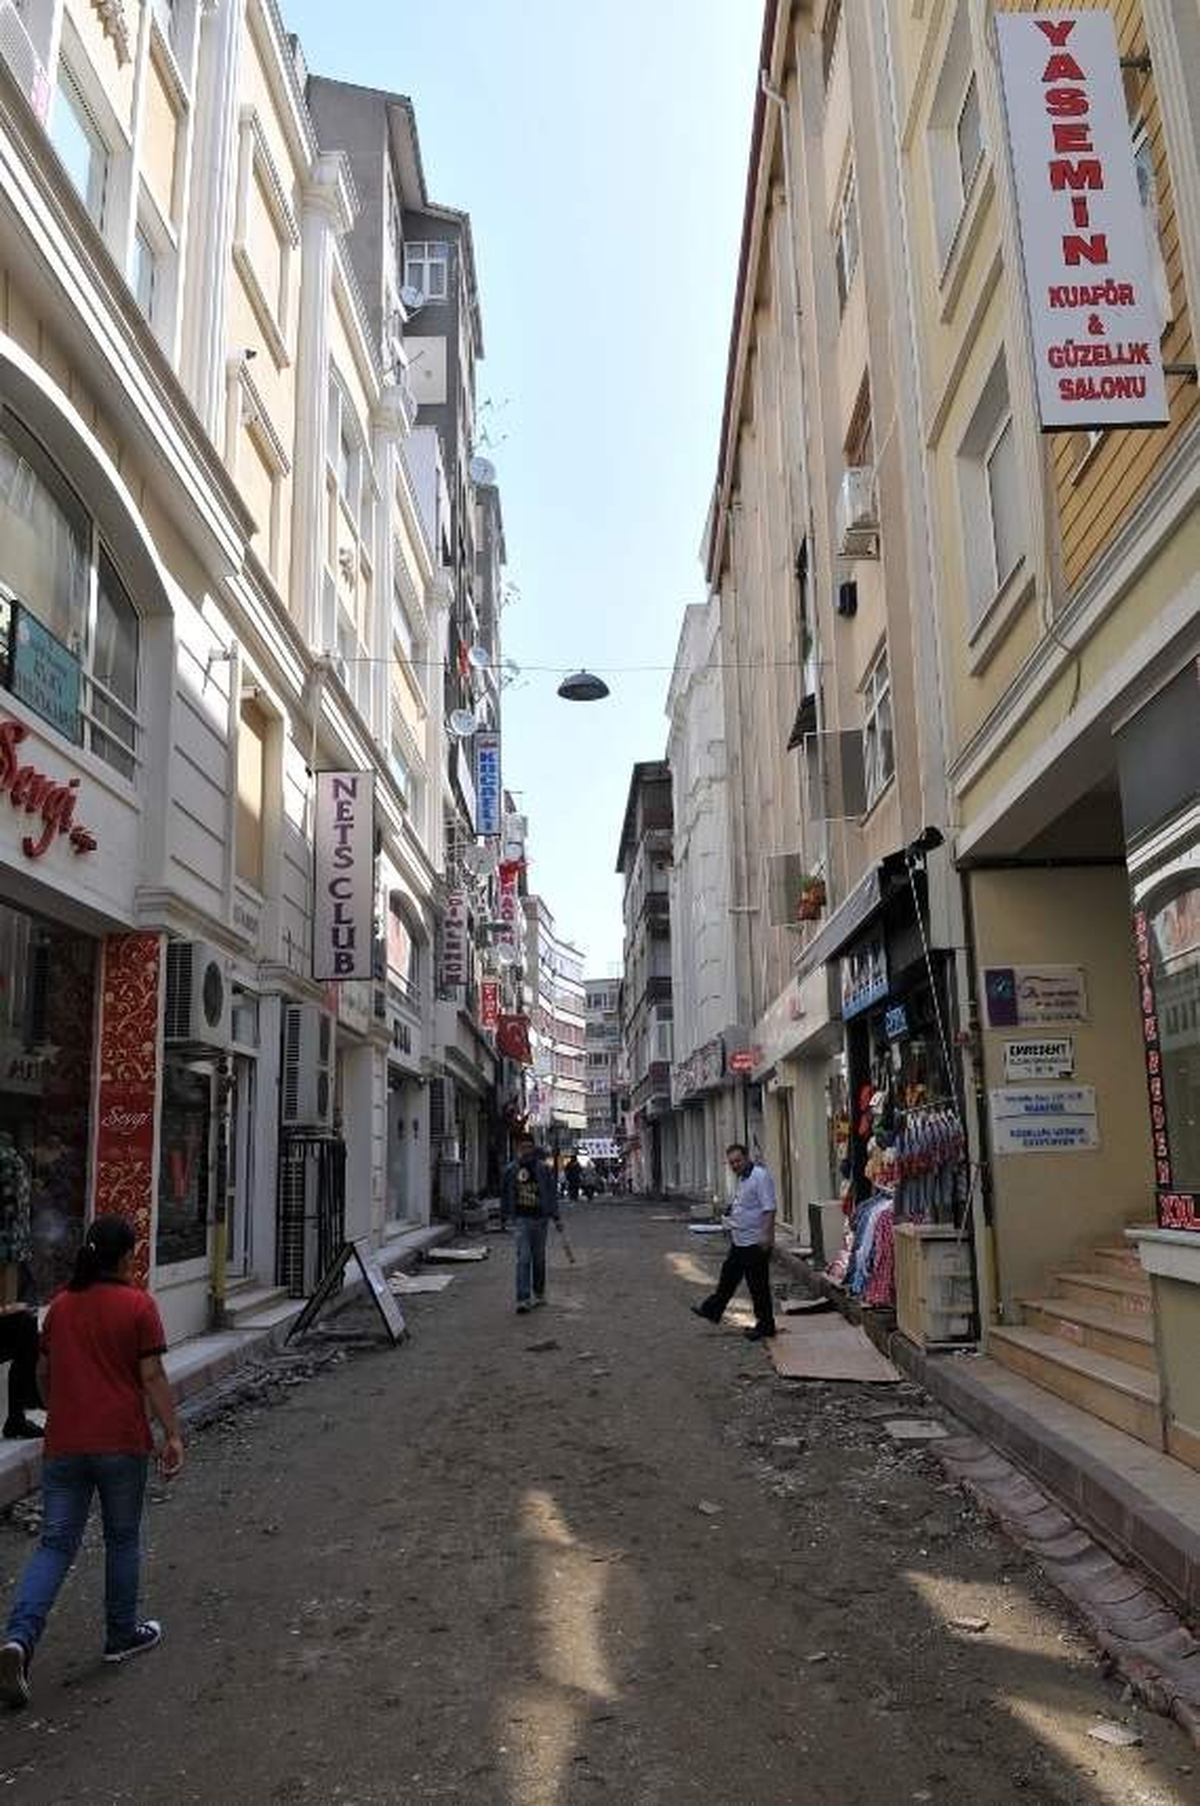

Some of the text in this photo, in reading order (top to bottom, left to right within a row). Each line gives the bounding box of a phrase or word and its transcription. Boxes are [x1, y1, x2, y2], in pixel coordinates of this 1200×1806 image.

[1033, 20, 1109, 267] YASEMIN
[1048, 279, 1136, 308] KUAFÖR
[1087, 313, 1105, 336] &
[1058, 376, 1147, 402] SALONU
